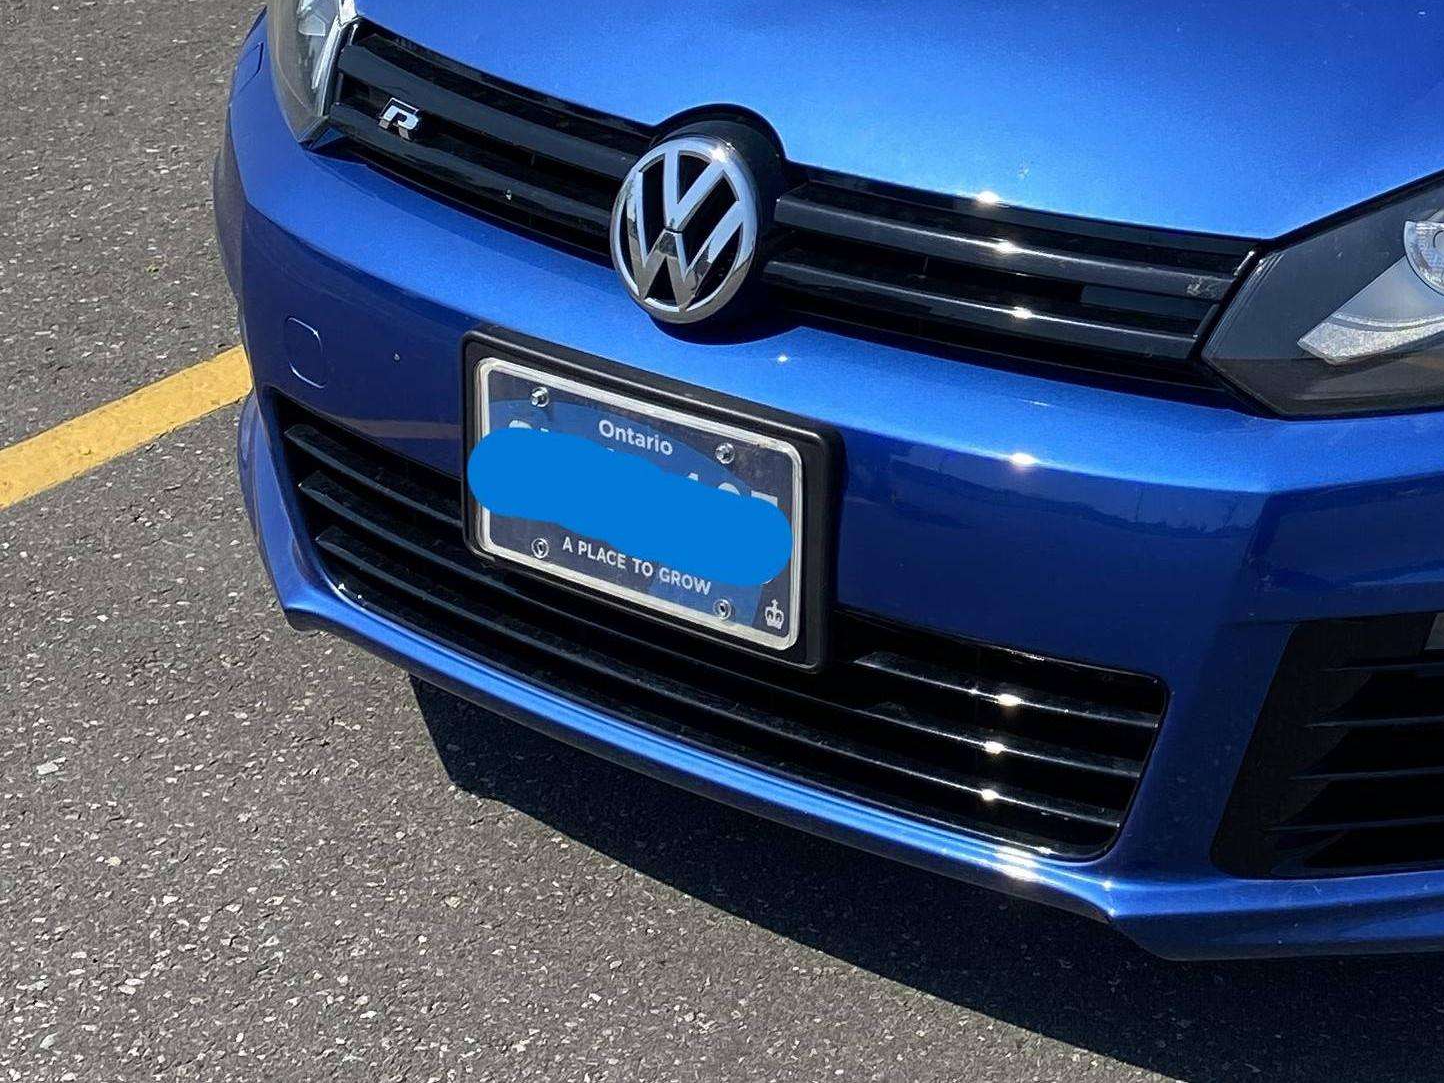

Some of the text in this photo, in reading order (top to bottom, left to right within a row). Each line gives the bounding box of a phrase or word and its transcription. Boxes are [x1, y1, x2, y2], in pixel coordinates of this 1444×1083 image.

[379, 104, 419, 140] R
[598, 419, 674, 456] Ontario
[562, 537, 712, 596] A PLACE TO GROW
